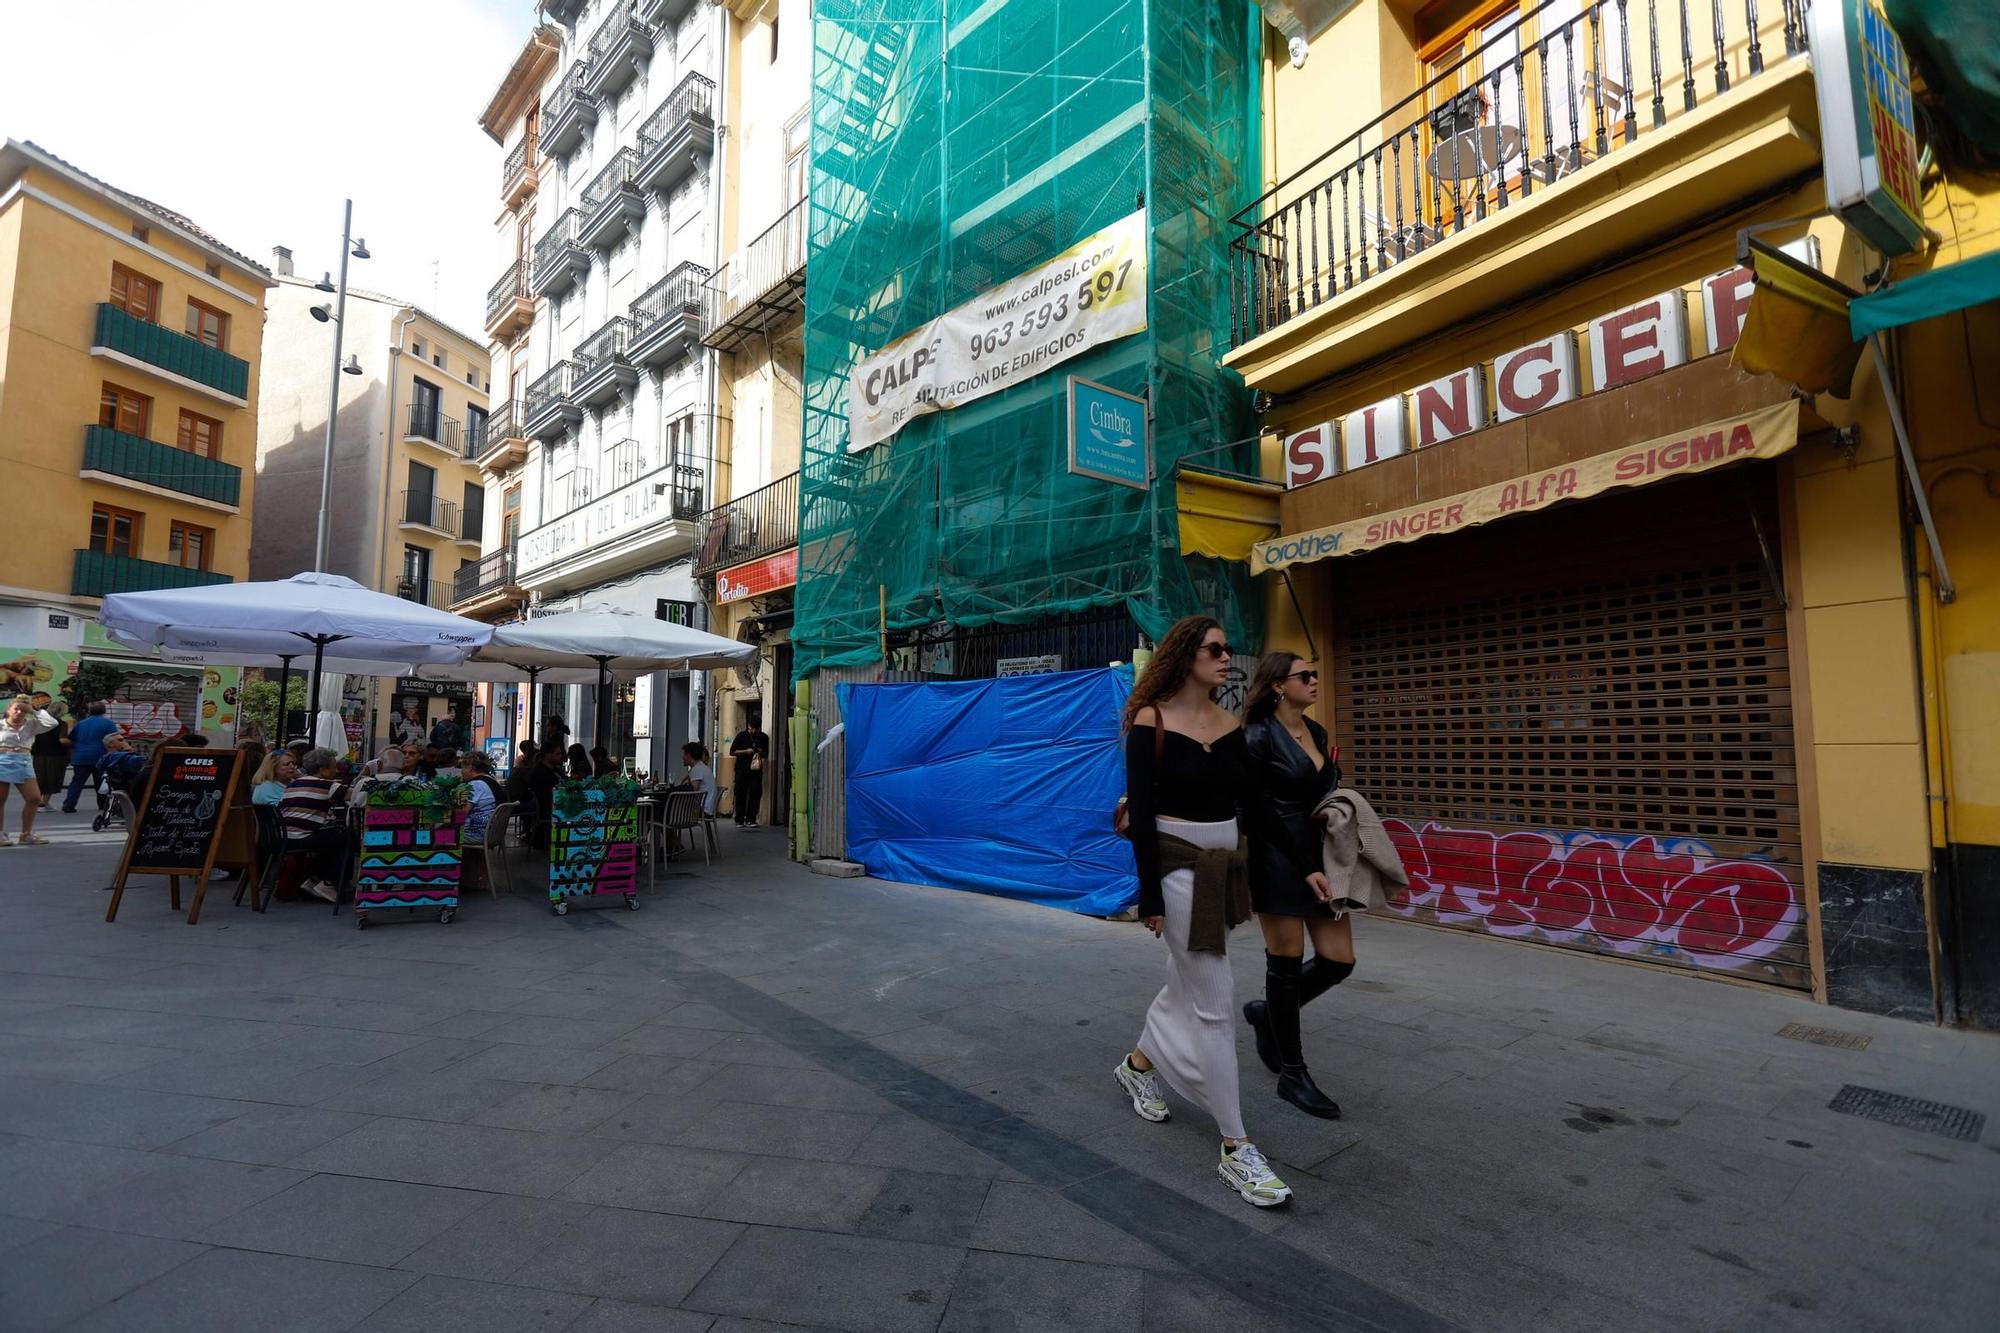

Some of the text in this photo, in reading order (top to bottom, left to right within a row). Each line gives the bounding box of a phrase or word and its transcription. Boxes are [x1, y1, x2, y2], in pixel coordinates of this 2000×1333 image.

[985, 245, 1115, 320] www.calpesl.com
[970, 258, 1134, 361] 963 593 597
[891, 328, 1087, 425] REBILITACIÓN DE EDIFICIOS
[1090, 401, 1132, 436] Cimbra
[597, 502, 616, 535] DEL
[623, 482, 657, 524] PILAR
[1264, 531, 1343, 565] brother
[1364, 503, 1465, 544] SINGER
[1614, 423, 1756, 480] SIGMA
[437, 632, 476, 643] Schweppes
[664, 602, 688, 627] TGB
[184, 758, 214, 766] CAFES
